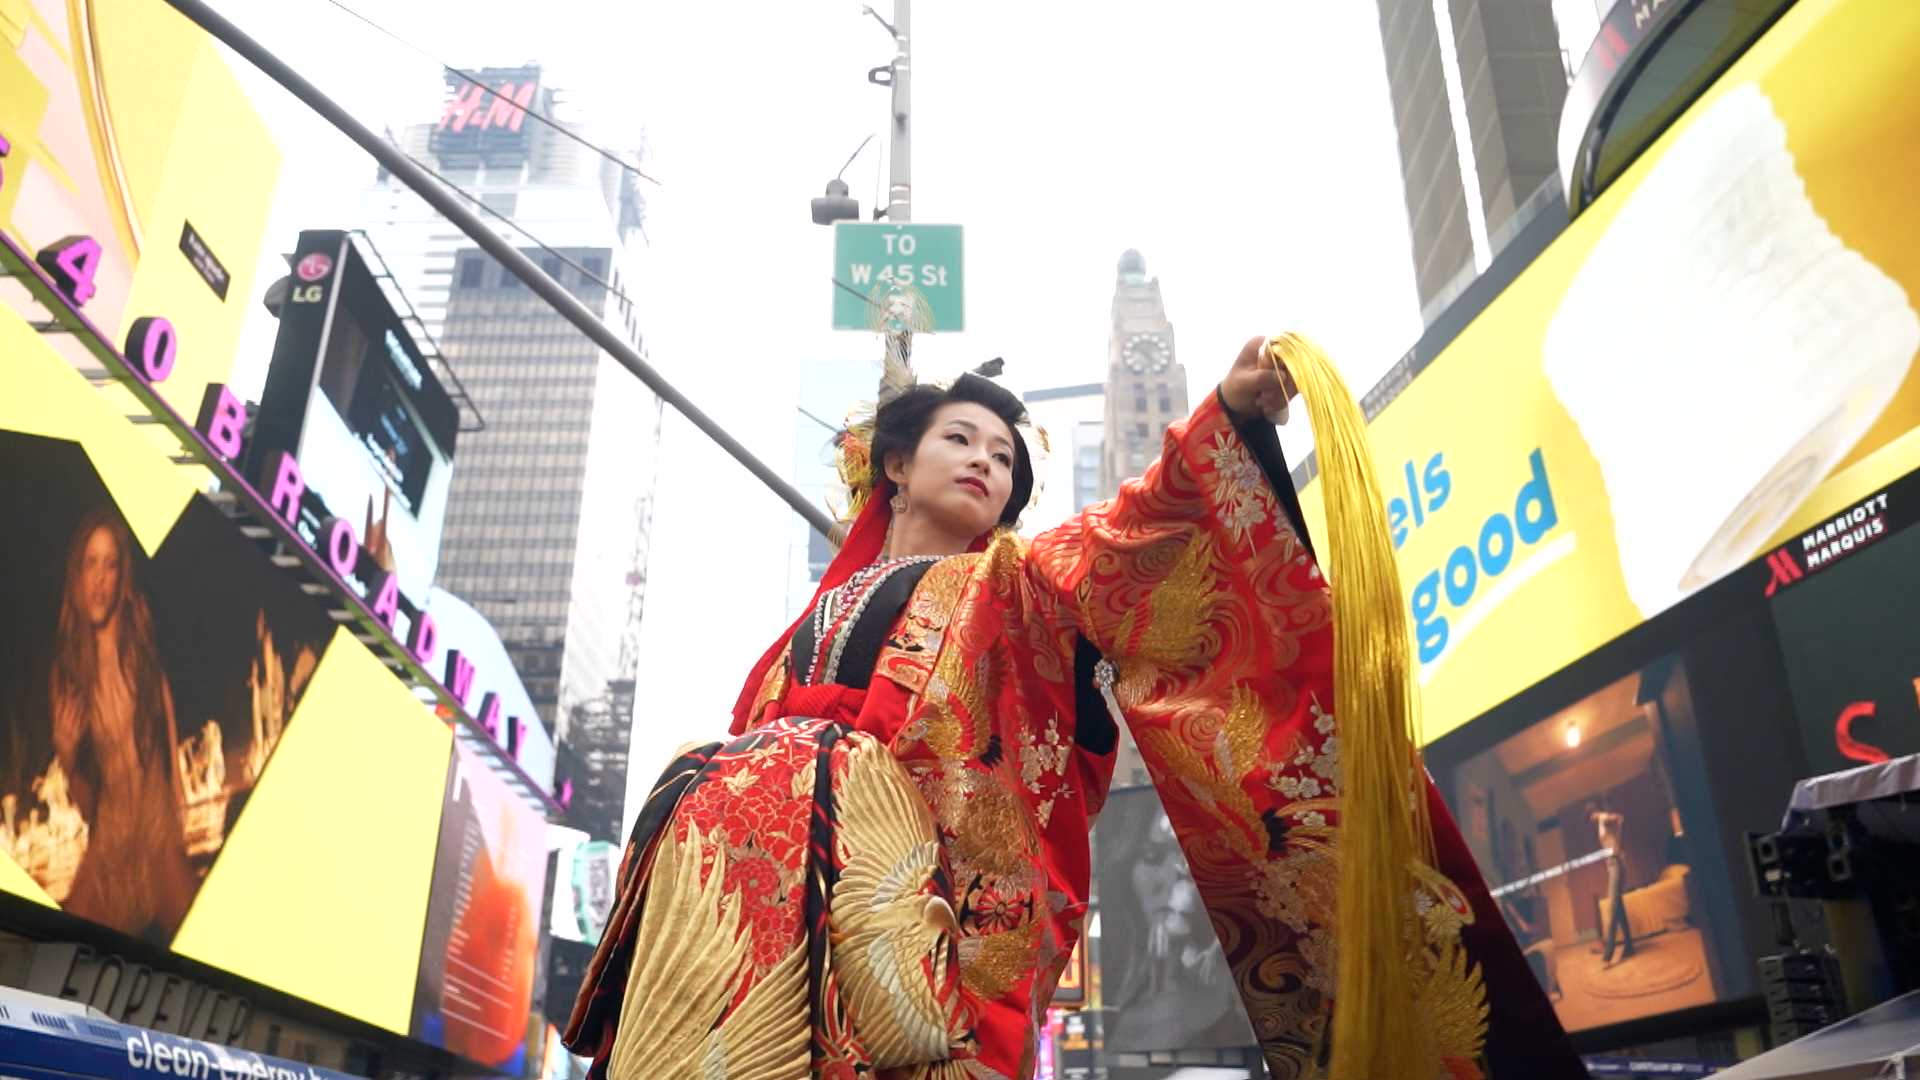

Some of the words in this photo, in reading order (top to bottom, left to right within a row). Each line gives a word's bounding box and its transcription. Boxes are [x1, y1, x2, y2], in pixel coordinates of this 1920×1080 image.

[881, 233, 917, 256] TO
[292, 286, 323, 302] LG
[850, 264, 873, 285] W
[876, 264, 916, 286] 45
[921, 264, 949, 287] St
[1387, 451, 1451, 551] els
[1802, 493, 1888, 551] MARRIOTT
[1411, 447, 1558, 665] good
[1806, 516, 1885, 568] MARQUIS
[207, 383, 528, 762] BROADWAY
